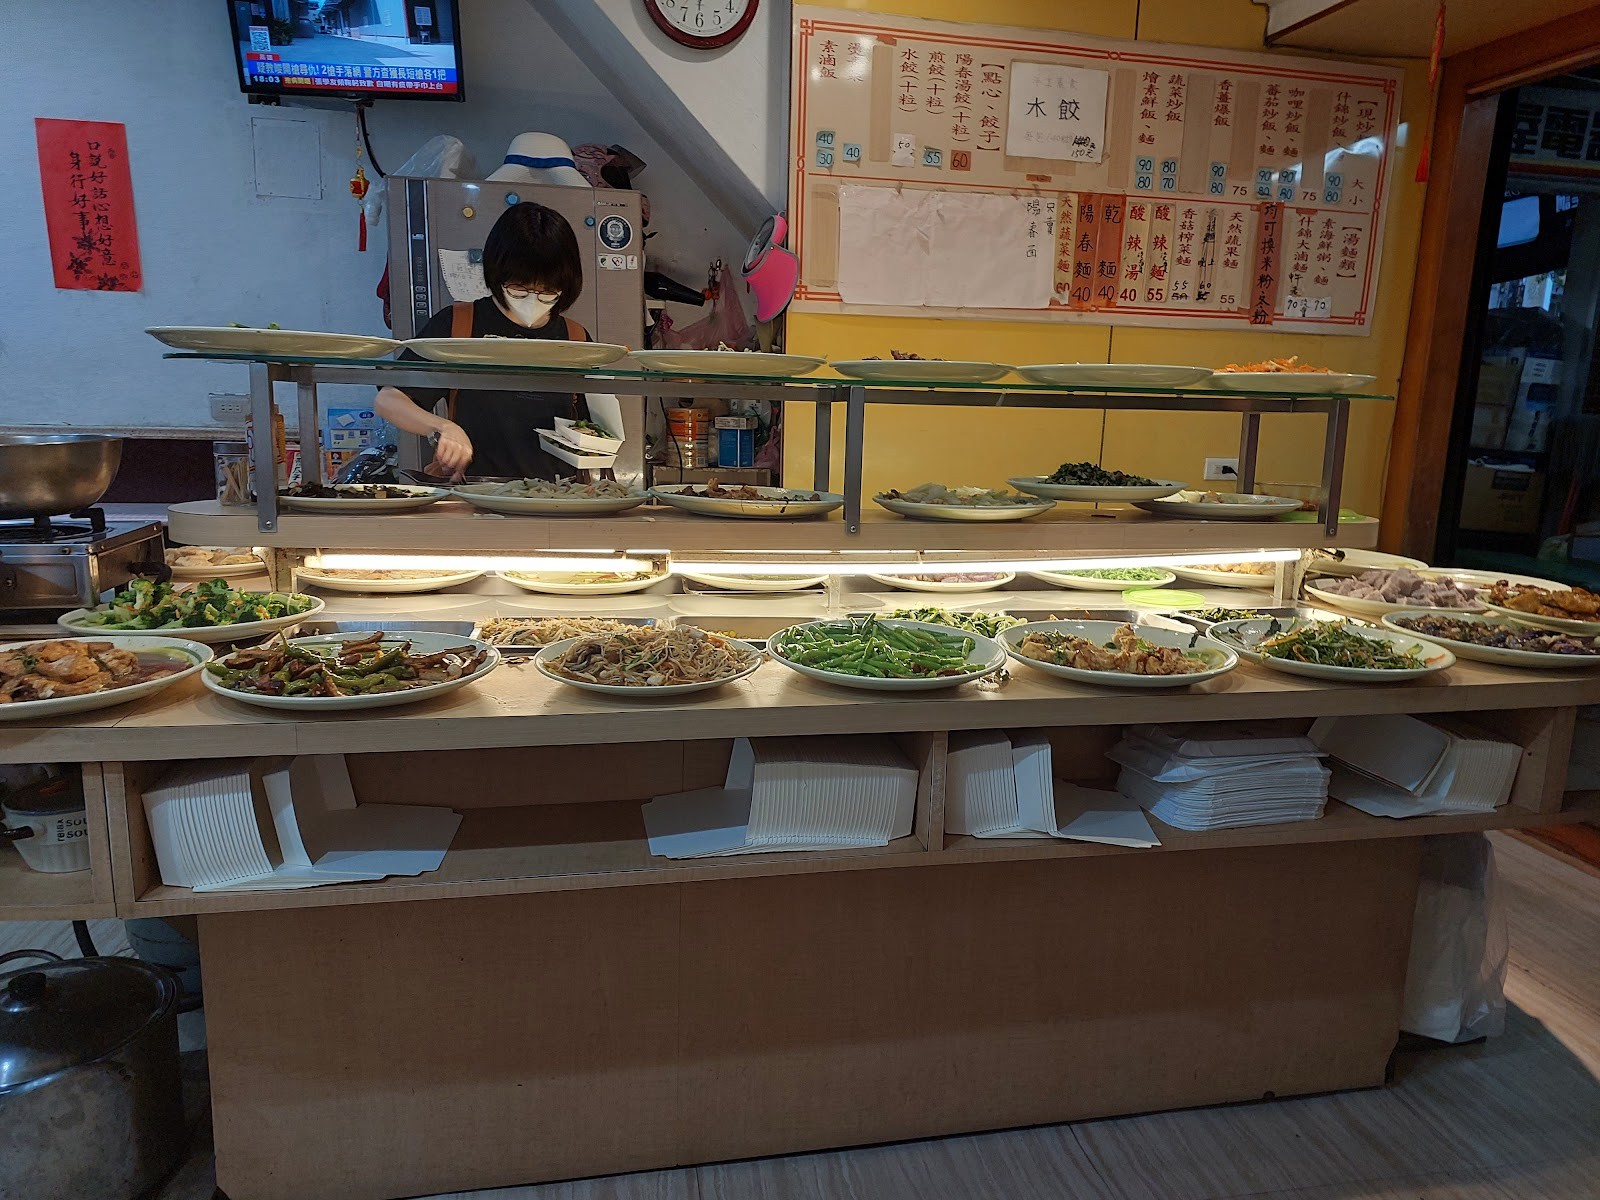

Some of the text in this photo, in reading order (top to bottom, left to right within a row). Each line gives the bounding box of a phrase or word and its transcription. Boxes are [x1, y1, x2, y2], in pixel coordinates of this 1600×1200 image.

[680, 6, 688, 22] 7
[713, 10, 721, 26] 5
[696, 12, 704, 28] 6
[253, 75, 280, 83] 18:03
[1166, 74, 1185, 122] 蔬菜炒飯
[1332, 92, 1351, 146] 什錦炒飯、
[818, 133, 834, 144] 40
[898, 140, 910, 149] 50
[846, 147, 860, 158] 40
[925, 152, 941, 164] 55
[818, 153, 833, 164] 30
[952, 153, 968, 168] 60
[1139, 159, 1152, 171] 90
[1162, 161, 1175, 173] 80
[1212, 166, 1224, 176] 90
[1259, 170, 1272, 181] 90
[1281, 171, 1294, 182] 90
[1137, 176, 1150, 188] 80
[1162, 178, 1174, 189] 70
[1328, 175, 1340, 186] 90
[1352, 179, 1364, 189] 大
[69, 151, 90, 230] 身行好事
[1211, 182, 1223, 193] 80
[1232, 186, 1247, 195] 75
[1280, 188, 1292, 200] 80
[1302, 192, 1316, 200] 75
[1326, 191, 1338, 202] 80
[1349, 196, 1362, 205] 小
[1057, 196, 1073, 273] 天然蔬菜麵
[1074, 204, 1093, 279] 陽春麵
[1098, 204, 1121, 278] 乾麵
[1125, 205, 1146, 280] 酸辣湯
[1150, 205, 1171, 281] 酸辣麵
[1056, 283, 1070, 294] 60
[1172, 280, 1188, 290] 55
[1072, 286, 1091, 301] 40
[1098, 285, 1114, 300] 40
[1120, 289, 1136, 301] 40
[1147, 288, 1163, 300] 55
[1220, 295, 1235, 303] 55
[1287, 300, 1298, 309] 70
[1314, 301, 1326, 311] 70
